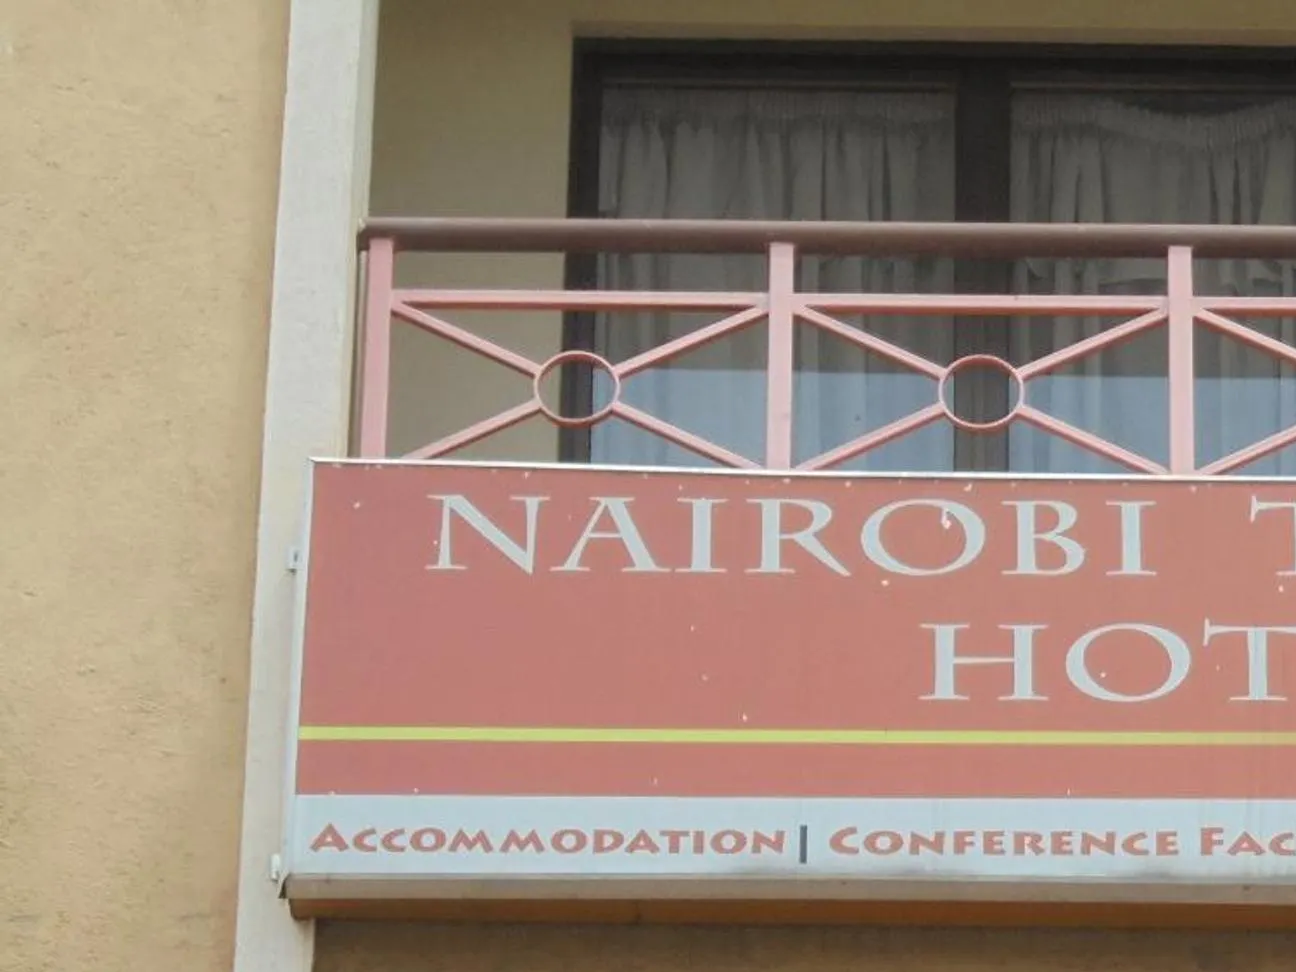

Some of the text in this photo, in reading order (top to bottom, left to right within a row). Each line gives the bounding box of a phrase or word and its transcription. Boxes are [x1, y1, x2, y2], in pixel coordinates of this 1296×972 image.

[425, 493, 1159, 578] NAIROBI
[308, 823, 787, 857] ACCOMMODATION
[828, 826, 1181, 859] CONFERENCE
